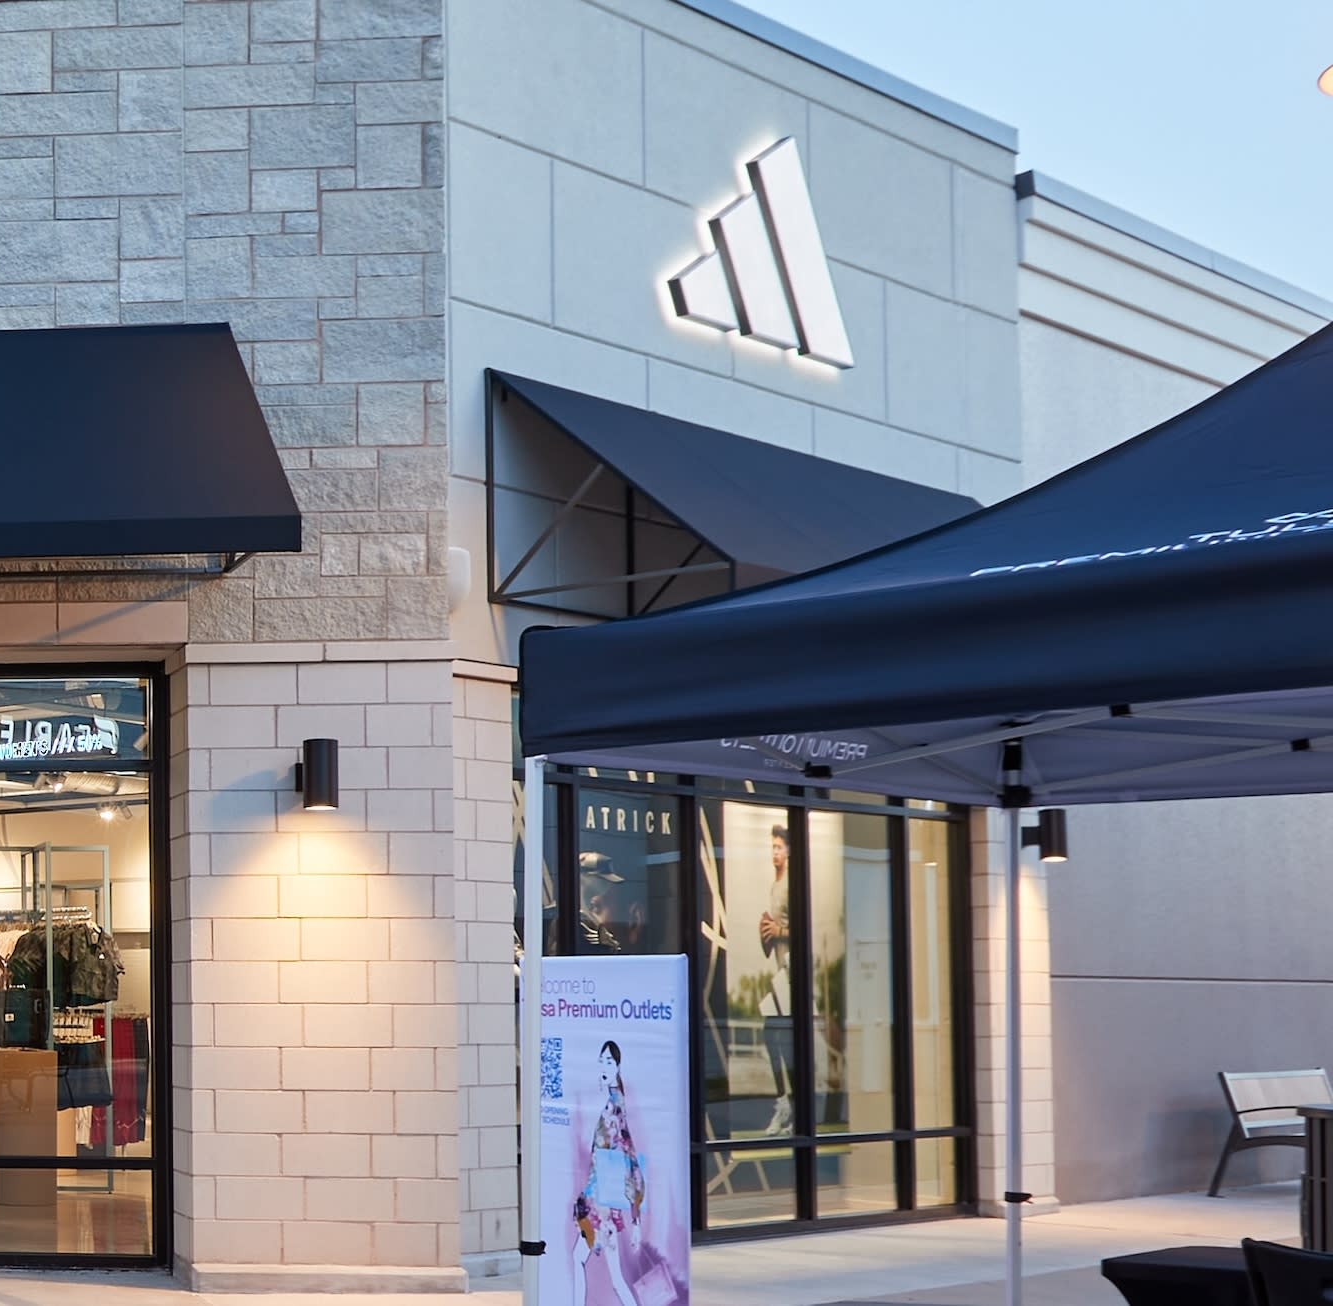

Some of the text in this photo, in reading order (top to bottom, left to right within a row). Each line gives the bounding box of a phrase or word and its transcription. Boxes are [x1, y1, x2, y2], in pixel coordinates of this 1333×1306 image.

[78, 733, 102, 753] 50%
[586, 806, 671, 835] ATRICK
[583, 977, 596, 995] to
[558, 998, 618, 1018] Premium
[621, 999, 673, 1020] Outlets
